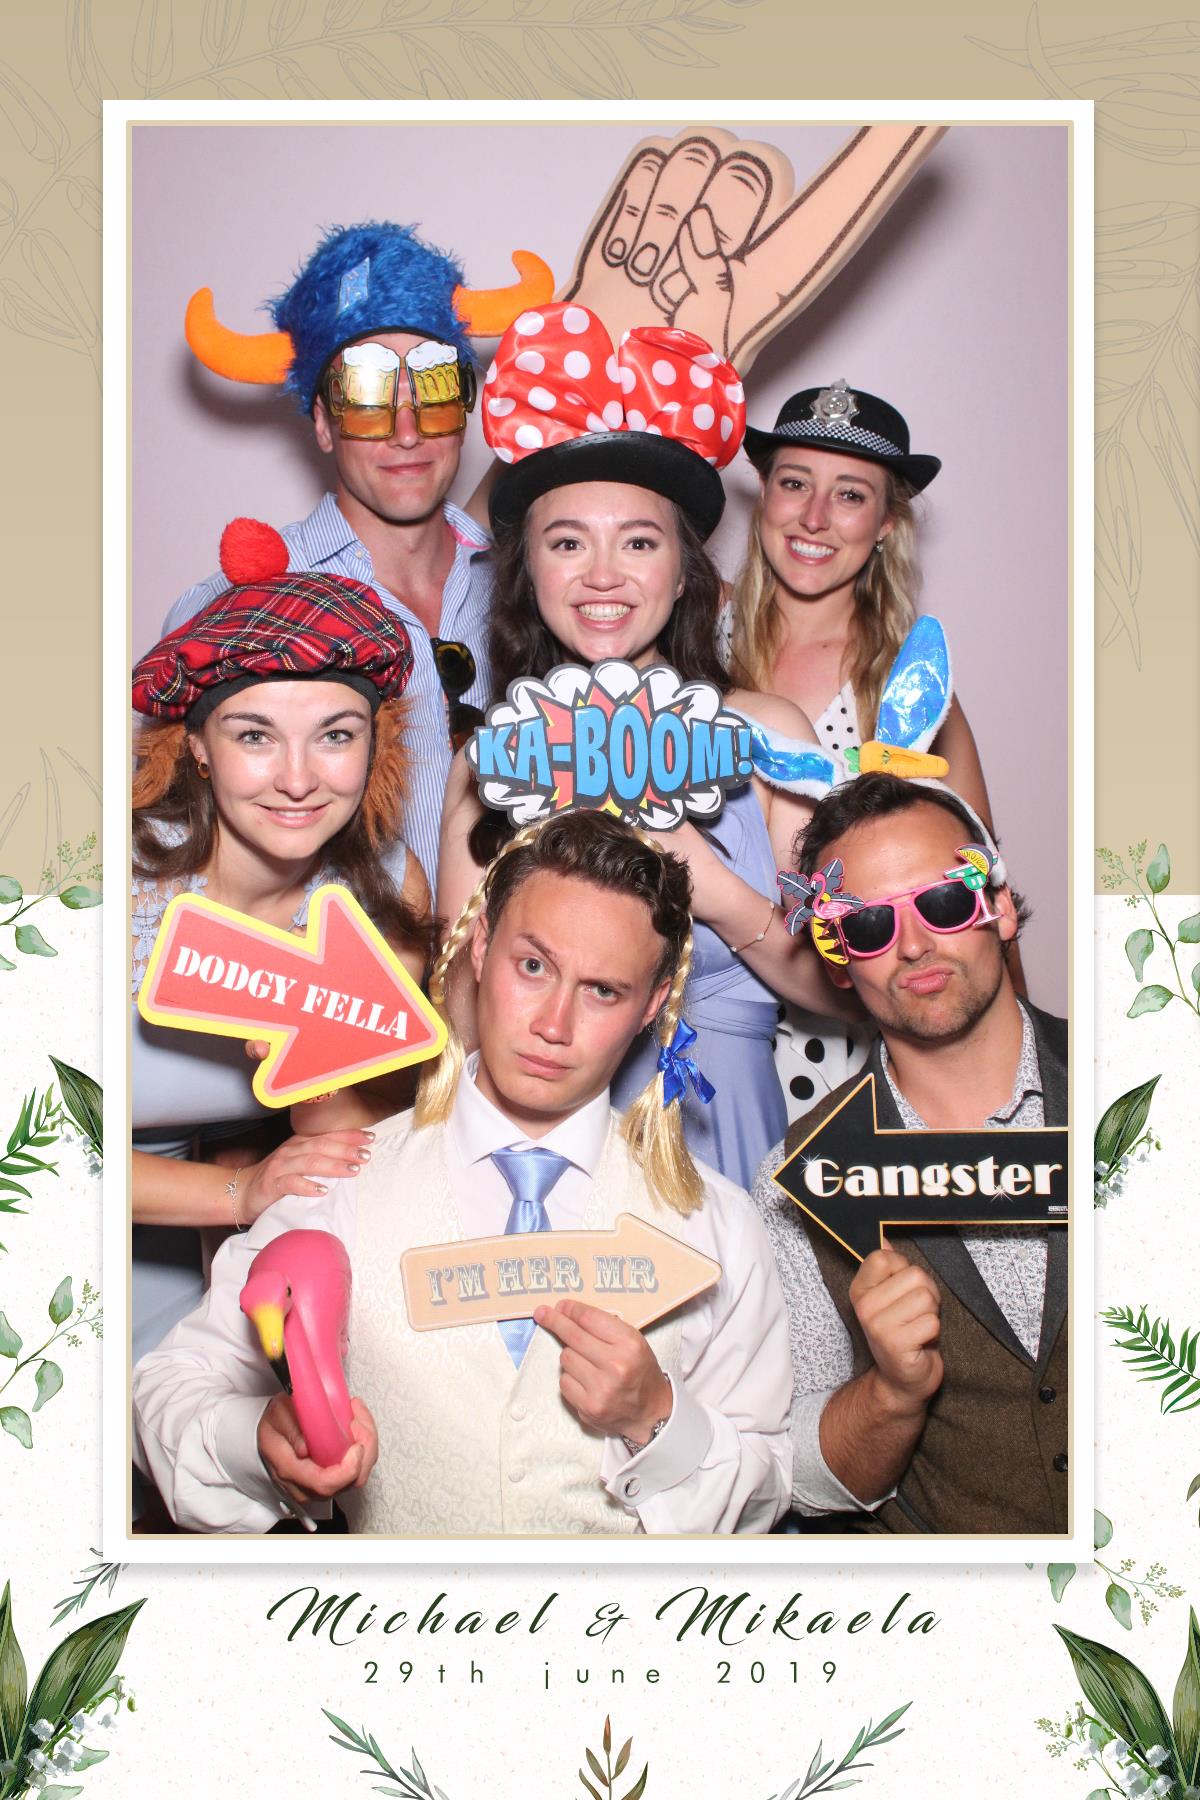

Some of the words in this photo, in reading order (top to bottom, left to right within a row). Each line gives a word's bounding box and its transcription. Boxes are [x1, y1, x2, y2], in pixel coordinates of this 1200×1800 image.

[478, 704, 752, 800] KA-BOOM!
[172, 946, 297, 1006] DODGY
[301, 984, 408, 1041] FELLA
[803, 1155, 1063, 1198] Gangster
[425, 1263, 490, 1306] I'M
[494, 1256, 583, 1296] HER
[593, 1255, 659, 1294] MR
